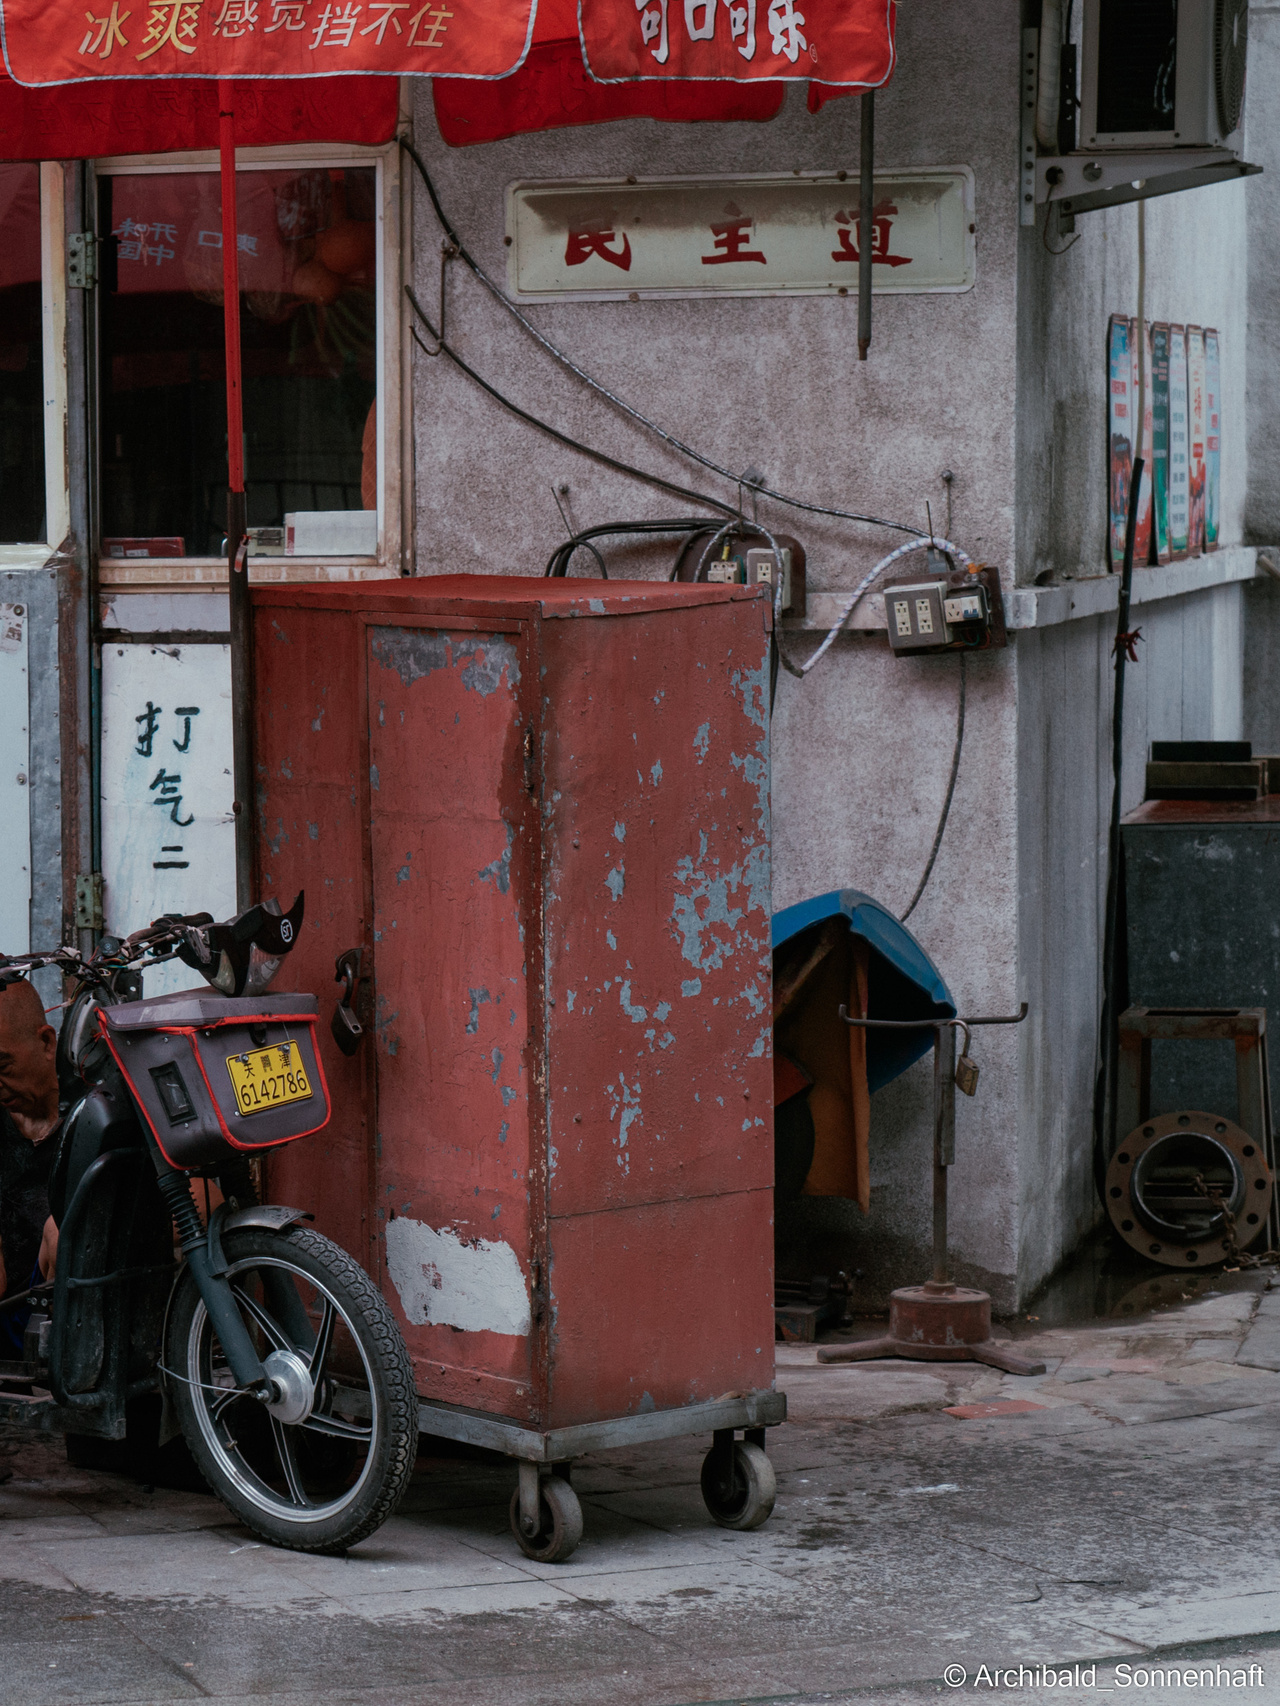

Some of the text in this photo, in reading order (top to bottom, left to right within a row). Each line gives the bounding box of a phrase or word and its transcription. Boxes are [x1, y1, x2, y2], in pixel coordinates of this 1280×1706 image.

[78, 0, 454, 61] 冰爽感觉挡不住
[635, 0, 807, 63] 可口可乐
[565, 200, 913, 272] 民主道
[135, 701, 200, 918] 打气二
[240, 1069, 307, 1107] 6142786
